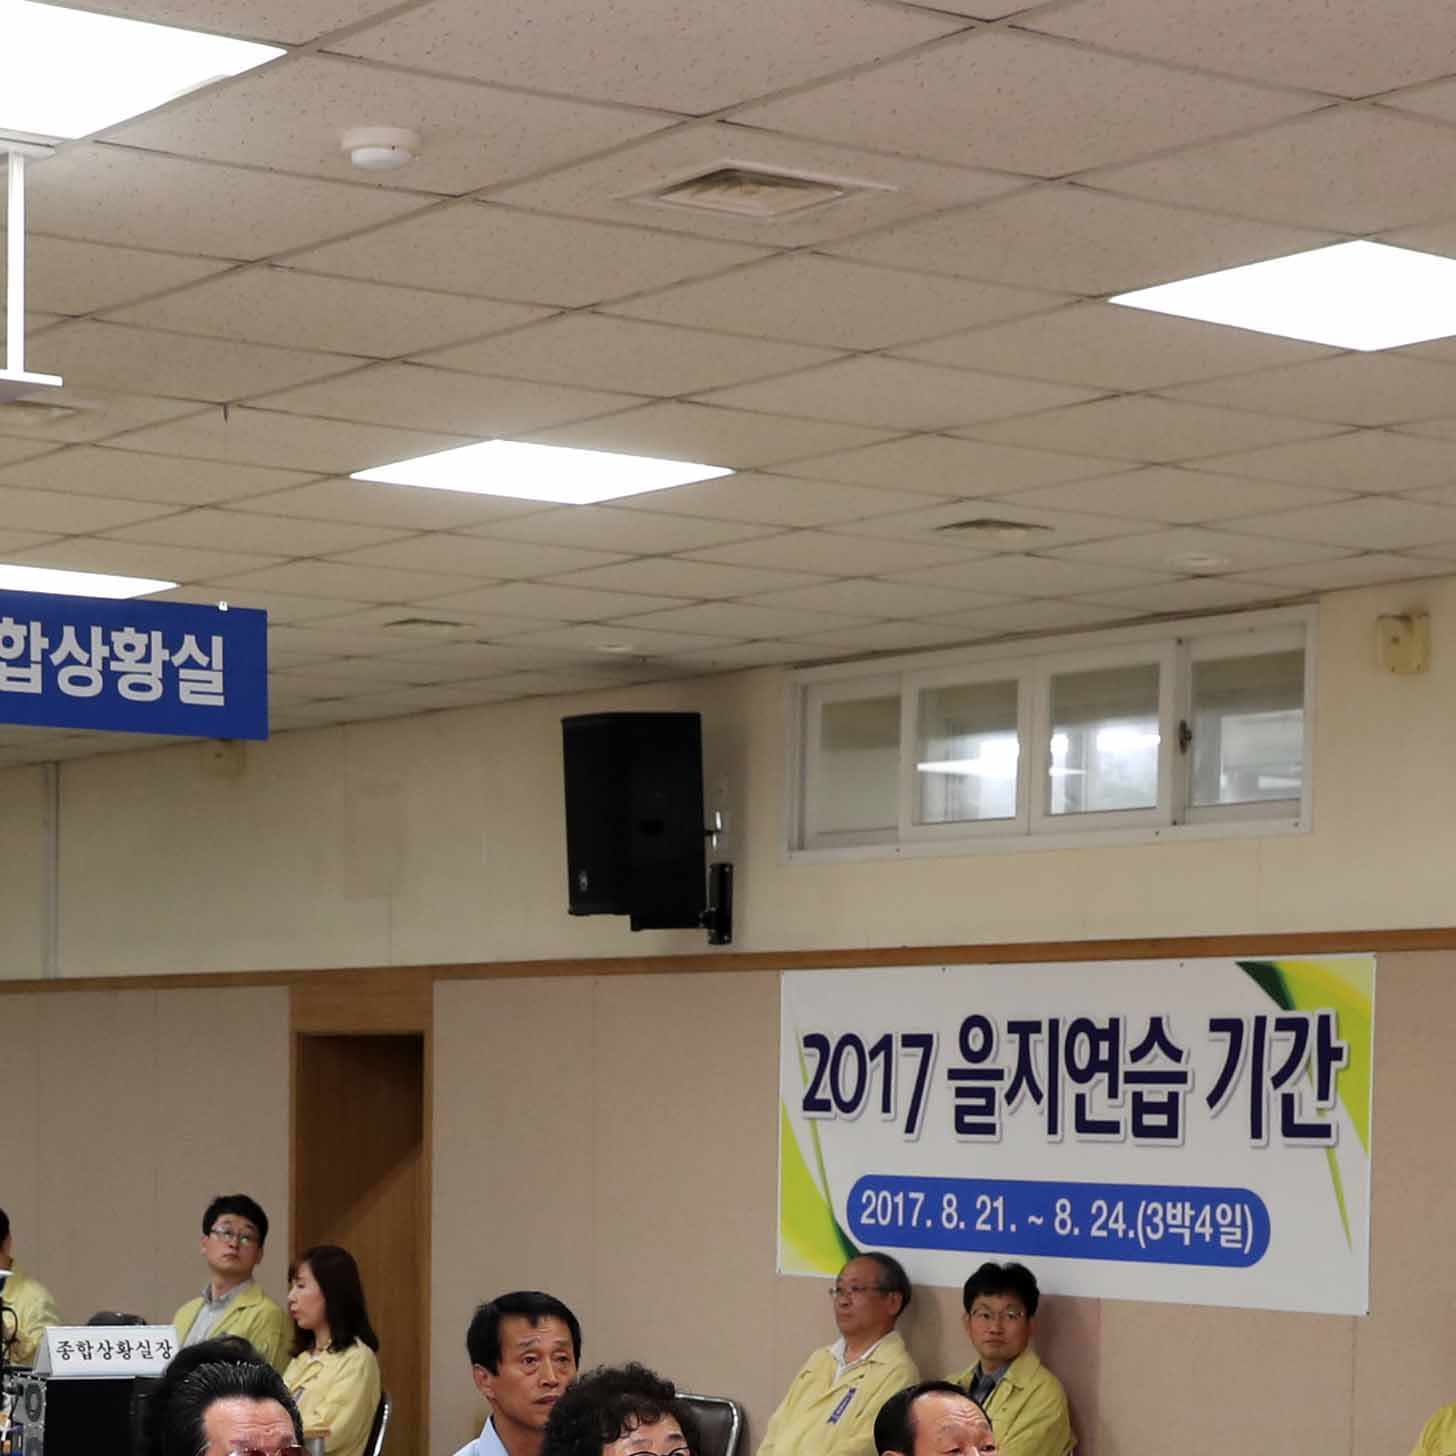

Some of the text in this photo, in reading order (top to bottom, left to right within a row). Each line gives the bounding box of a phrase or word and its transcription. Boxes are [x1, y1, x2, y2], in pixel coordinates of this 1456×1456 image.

[801, 1014, 1344, 1140] 2017 을지연습 기간
[860, 1189, 932, 1229] 2017.
[942, 1193, 966, 1230] 8.
[975, 1195, 1016, 1233] 21.
[1054, 1198, 1080, 1236] 8.
[55, 1339, 174, 1361] 종합상황실장
